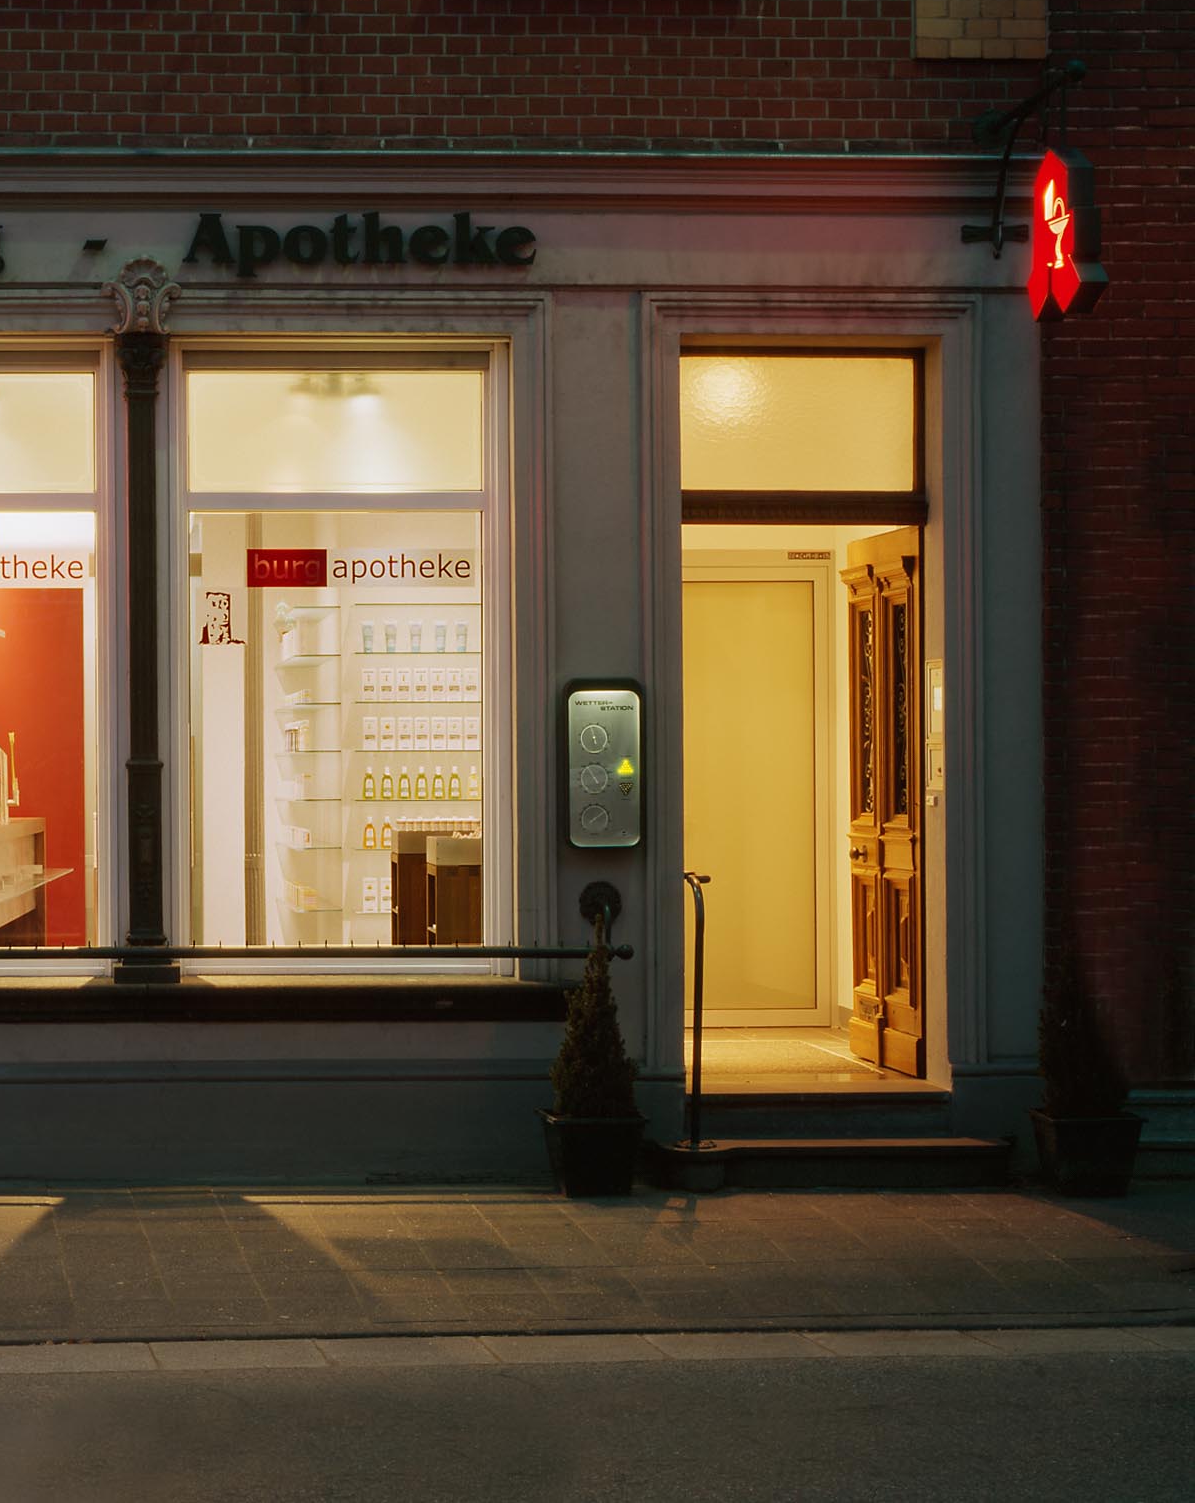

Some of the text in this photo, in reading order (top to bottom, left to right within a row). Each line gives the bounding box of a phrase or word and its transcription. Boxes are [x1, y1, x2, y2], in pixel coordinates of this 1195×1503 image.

[182, 212, 537, 278] Apotheke
[254, 553, 471, 585] burg apotheke
